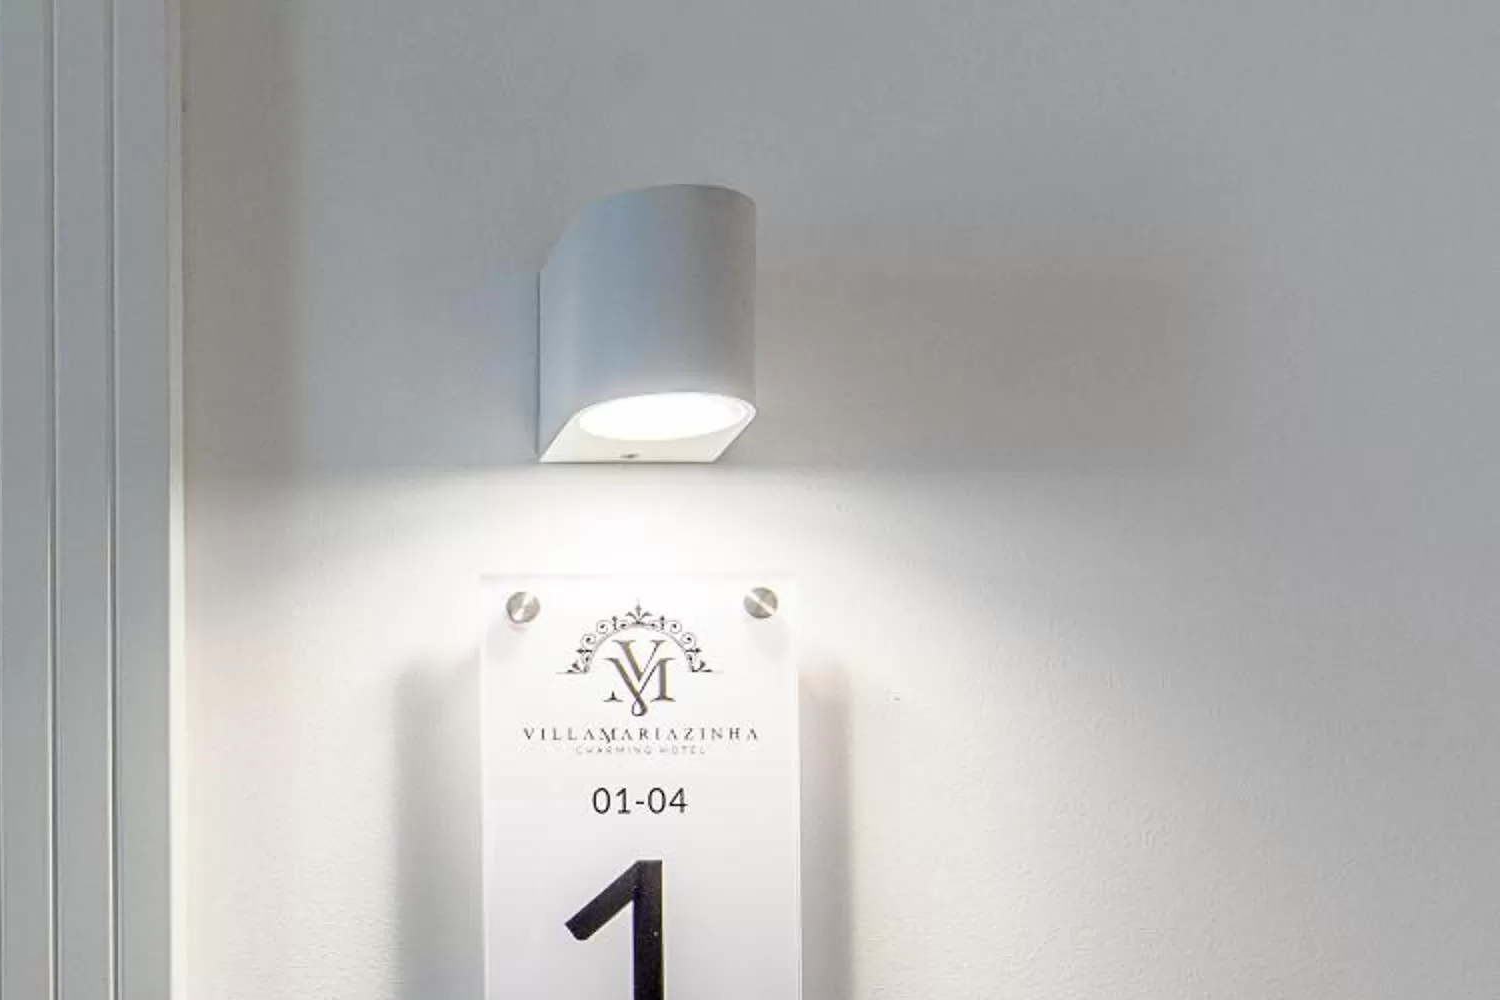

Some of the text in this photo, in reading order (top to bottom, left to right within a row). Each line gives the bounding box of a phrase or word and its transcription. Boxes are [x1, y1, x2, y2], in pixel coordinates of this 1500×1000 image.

[522, 727, 759, 743] VILLAMARIAZINHA
[575, 745, 706, 755] CHARMING HOTEL
[592, 787, 688, 815] 01-04
